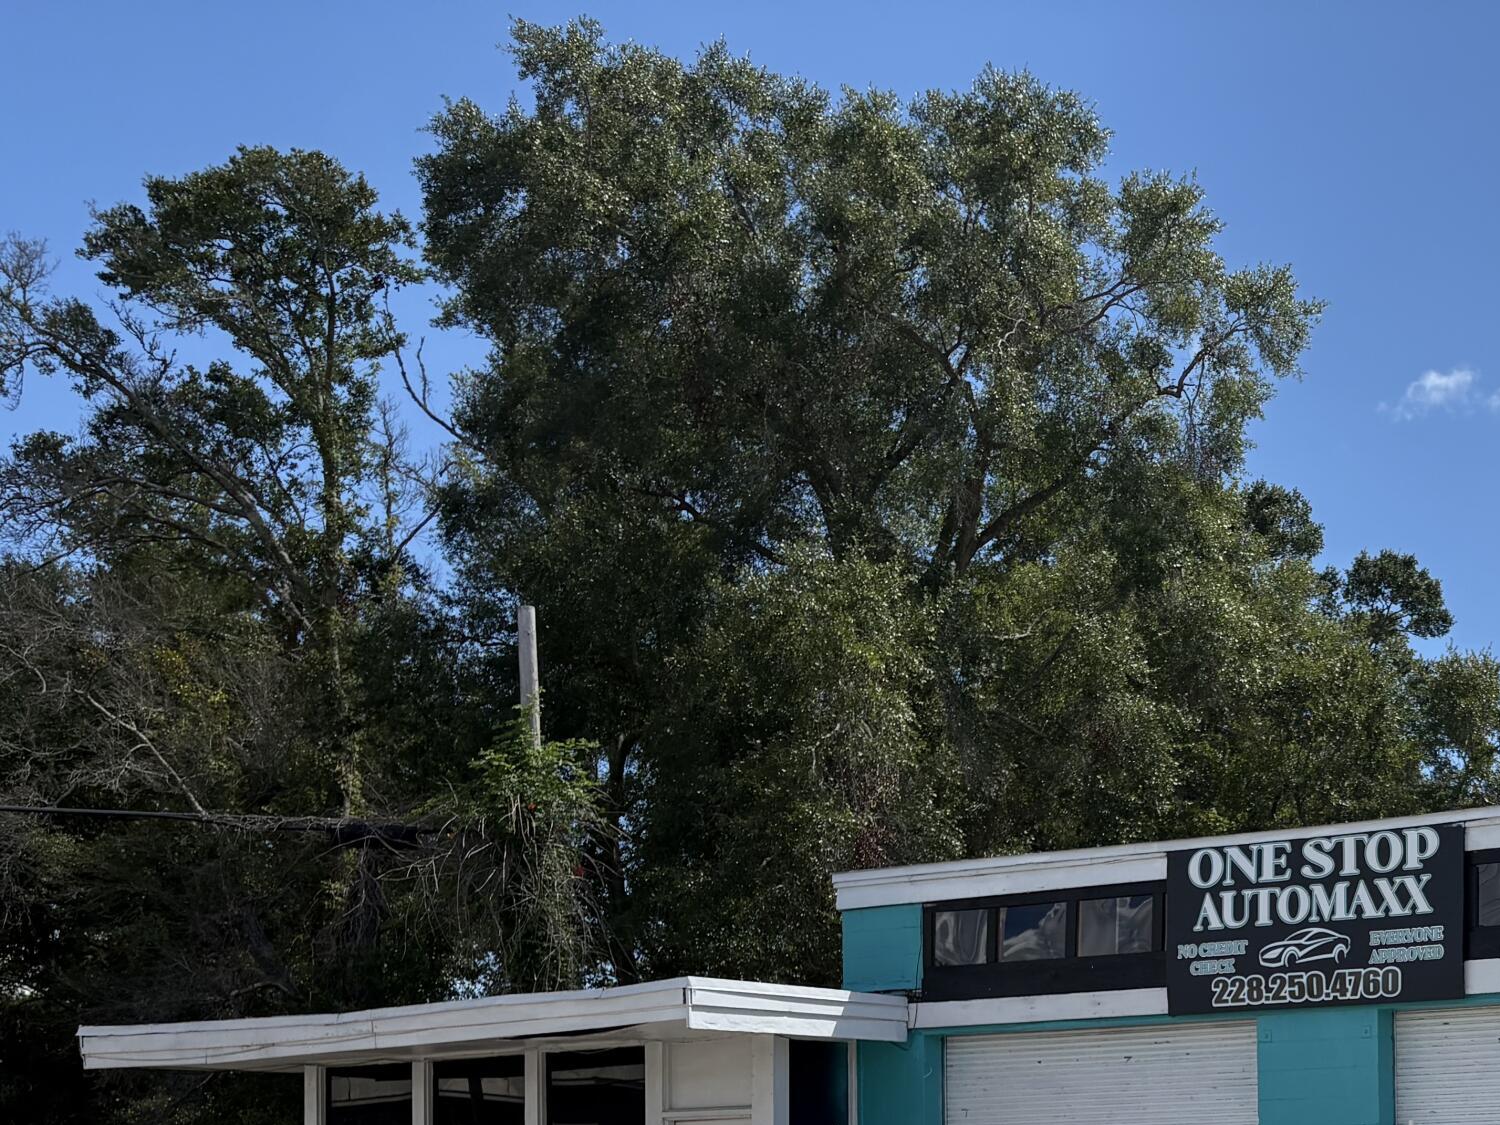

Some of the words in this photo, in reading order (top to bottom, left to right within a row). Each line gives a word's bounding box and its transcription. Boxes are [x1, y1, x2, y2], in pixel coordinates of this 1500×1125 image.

[1187, 841, 1292, 889] ONE
[1300, 827, 1440, 879] STOP
[1193, 873, 1434, 932] AUTOMAXX
[1369, 925, 1444, 946] EVERYONE
[1177, 944, 1198, 959] NO
[1199, 939, 1248, 957] CREDIT
[1368, 944, 1444, 964] APPROVED
[1190, 958, 1236, 976] CHECK
[1211, 966, 1402, 1007] 228.250.4760
